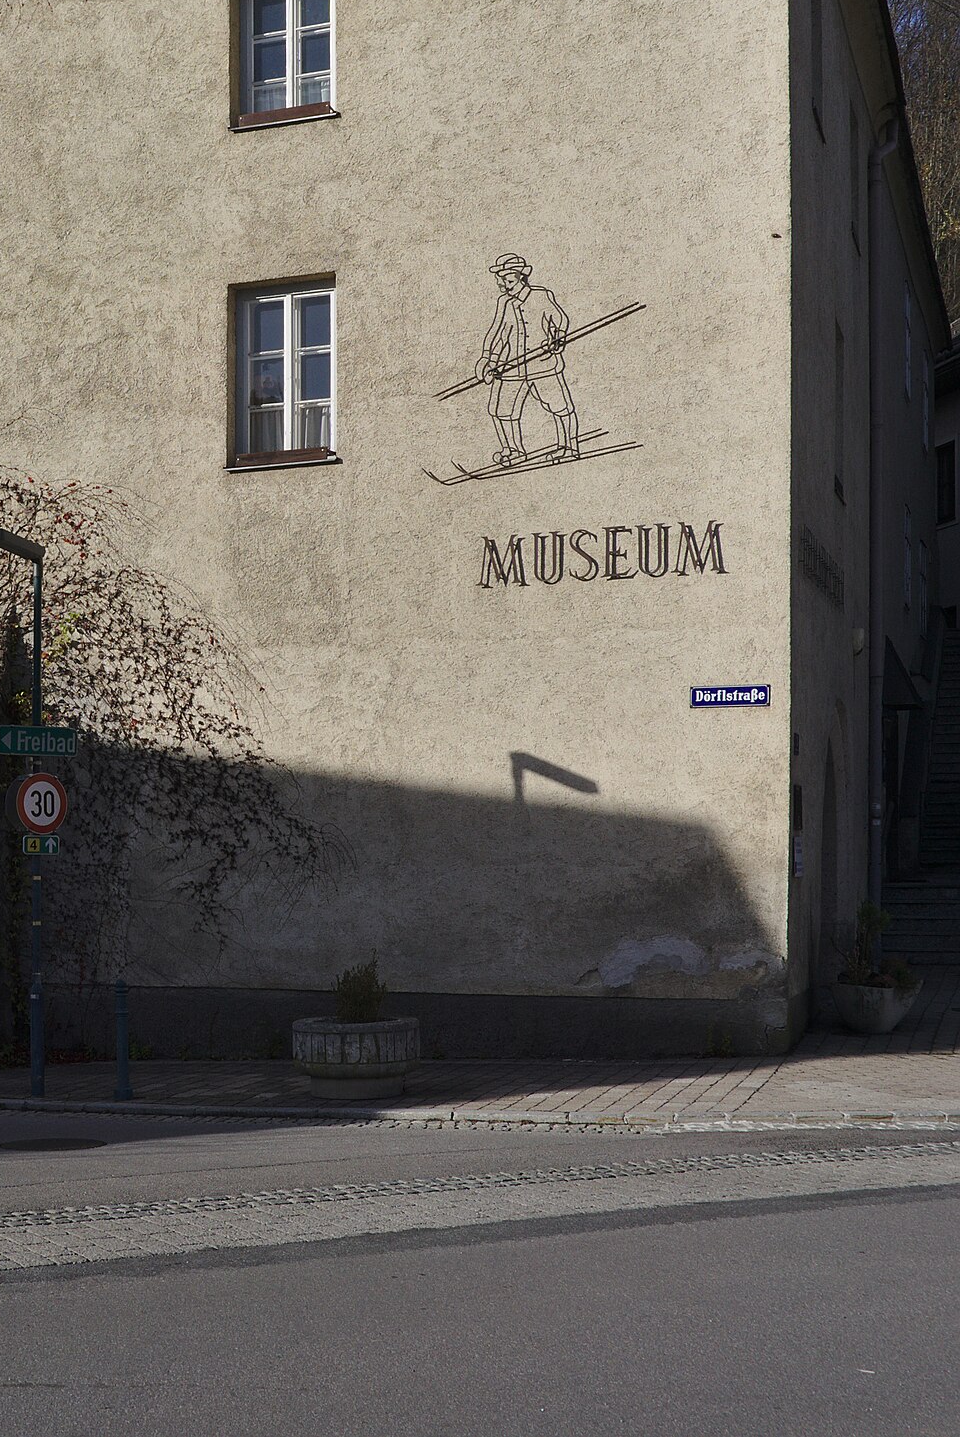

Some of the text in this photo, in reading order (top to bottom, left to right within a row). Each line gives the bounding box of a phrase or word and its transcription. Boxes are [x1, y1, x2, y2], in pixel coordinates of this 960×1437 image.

[475, 519, 729, 589] MUSEUM
[695, 688, 766, 703] Dörflstraße
[17, 730, 76, 754] Freibad
[30, 790, 55, 818] 30
[29, 838, 38, 851] 4
